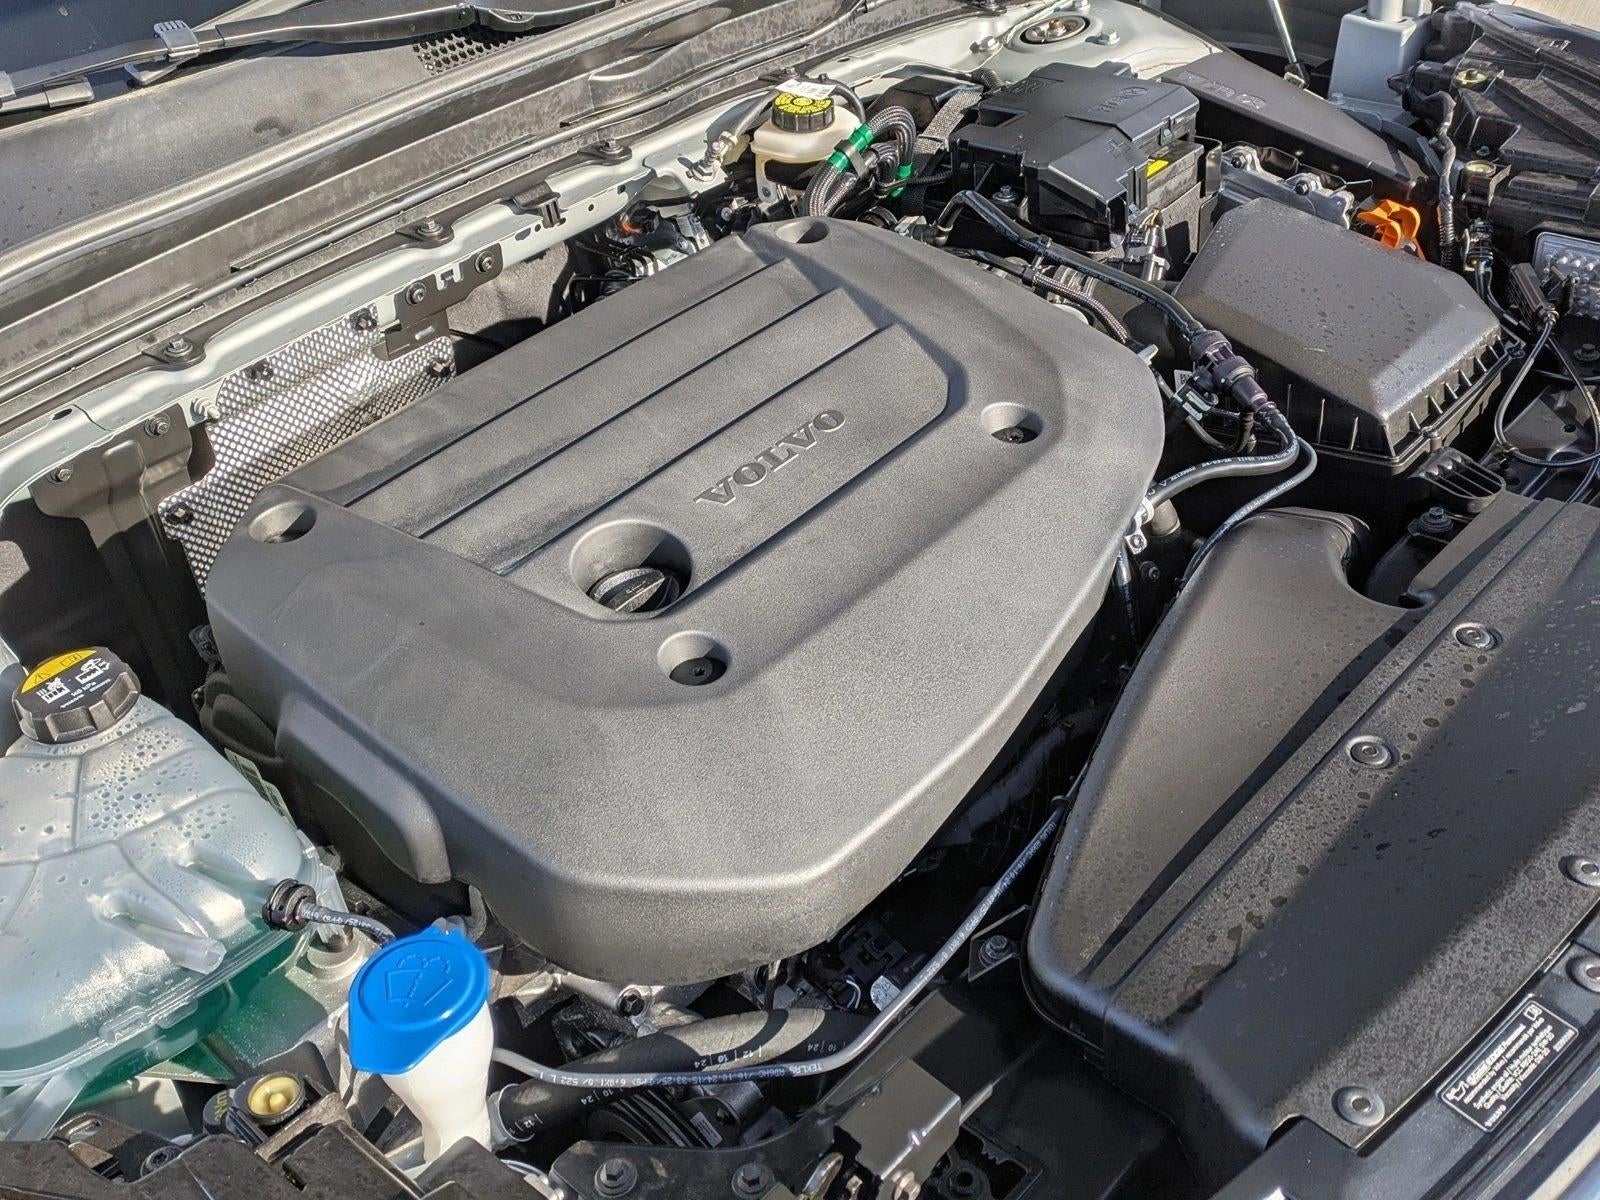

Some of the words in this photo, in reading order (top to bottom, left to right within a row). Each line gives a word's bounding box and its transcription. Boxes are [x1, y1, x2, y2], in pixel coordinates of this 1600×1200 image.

[692, 409, 845, 506] VOLVO
[807, 1043, 819, 1051] 24
[694, 1059, 707, 1068] 24
[789, 1064, 823, 1075] TEKLAS
[561, 1075, 578, 1086] 522
[581, 1095, 594, 1105] 24
[1484, 1104, 1507, 1128] VOLVO
